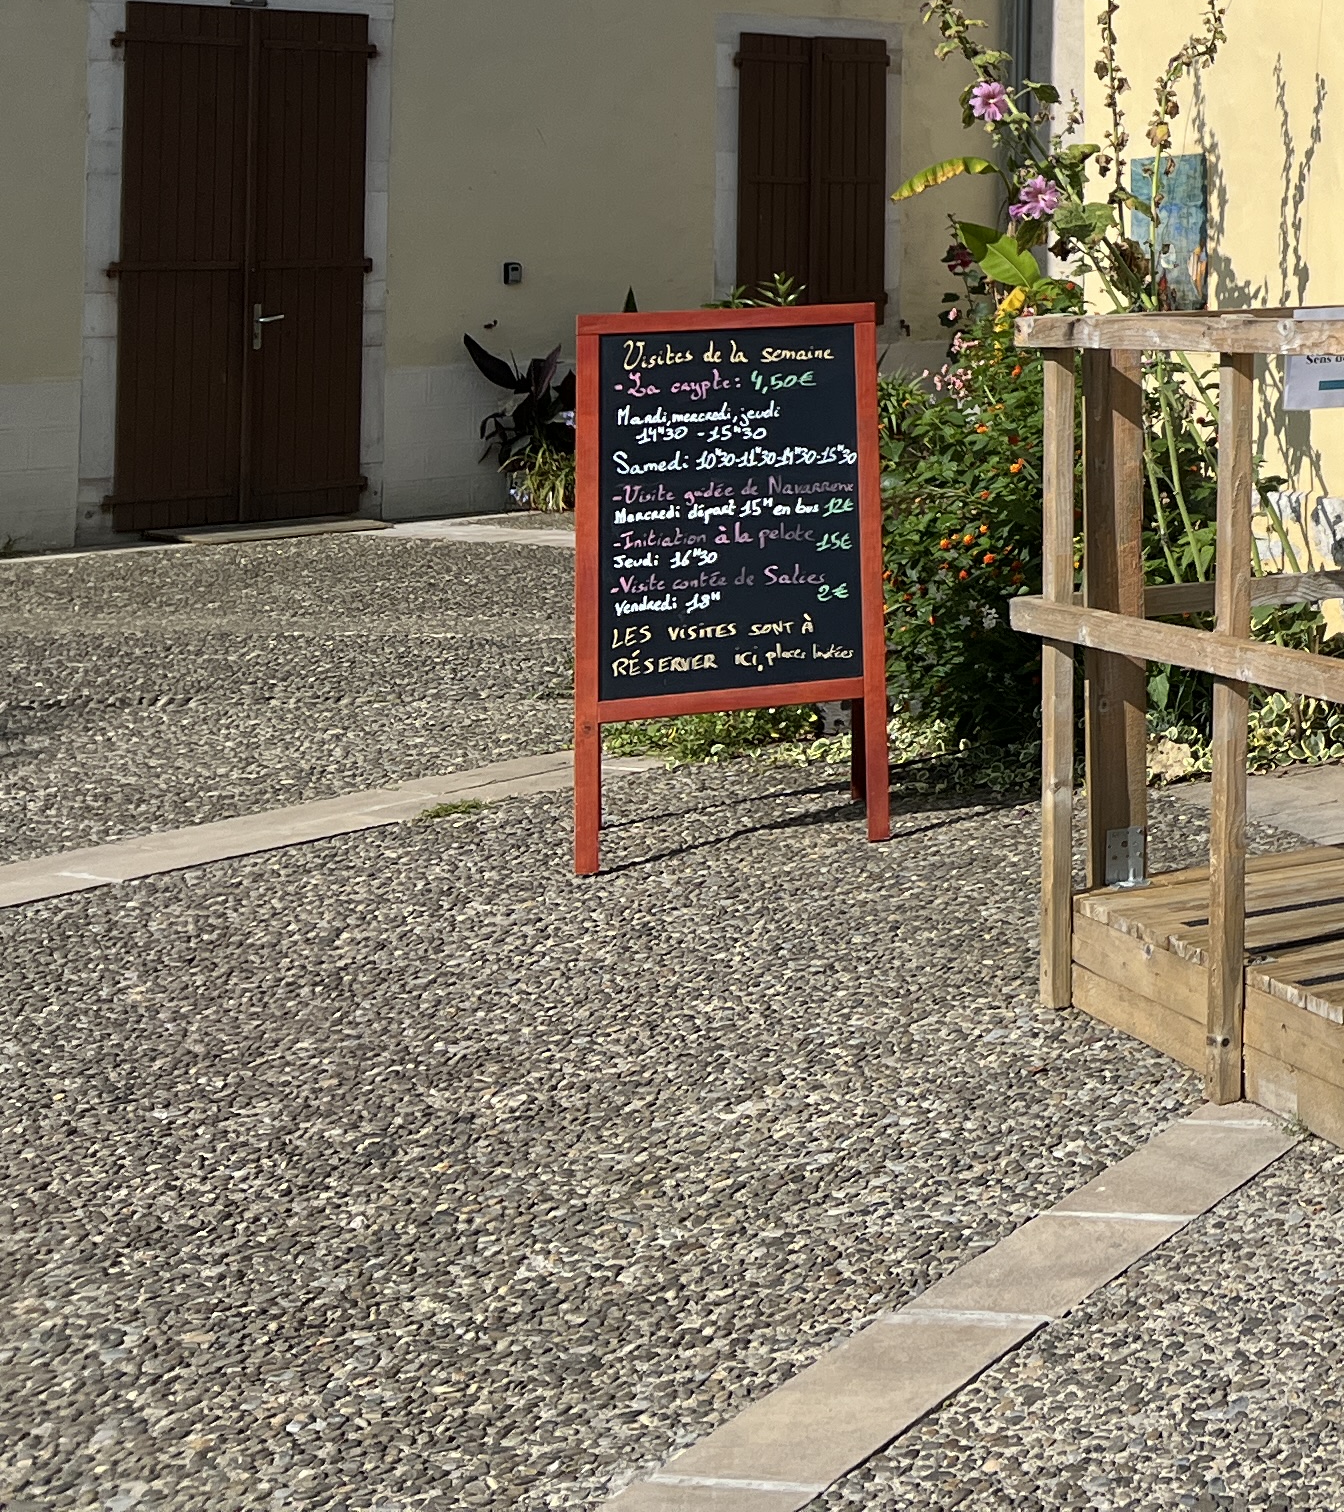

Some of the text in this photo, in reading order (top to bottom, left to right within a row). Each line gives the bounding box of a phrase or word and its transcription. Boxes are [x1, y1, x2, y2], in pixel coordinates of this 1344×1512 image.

[623, 339, 836, 370] Visites de la semaine
[750, 370, 817, 395] 4,50€
[612, 450, 690, 476] Samedi
[684, 483, 734, 507] guidée
[741, 478, 759, 496] de
[614, 506, 681, 524] Mercredi
[772, 501, 790, 516] en
[796, 497, 820, 514] bus
[822, 498, 854, 518] 12€
[714, 524, 730, 544] à
[734, 522, 754, 543] la
[758, 522, 816, 548] pelote
[816, 532, 853, 552] 15€
[612, 554, 660, 570] Jeudi
[672, 572, 729, 590] contée
[734, 567, 754, 586] de
[764, 564, 826, 586] Salies
[614, 594, 678, 617] Vendredi
[816, 582, 850, 602] 2€
[612, 625, 652, 650] LES
[748, 620, 796, 637] SONT
[802, 613, 814, 634] À
[612, 652, 718, 678] RÉSERVER
[765, 643, 806, 666] places
